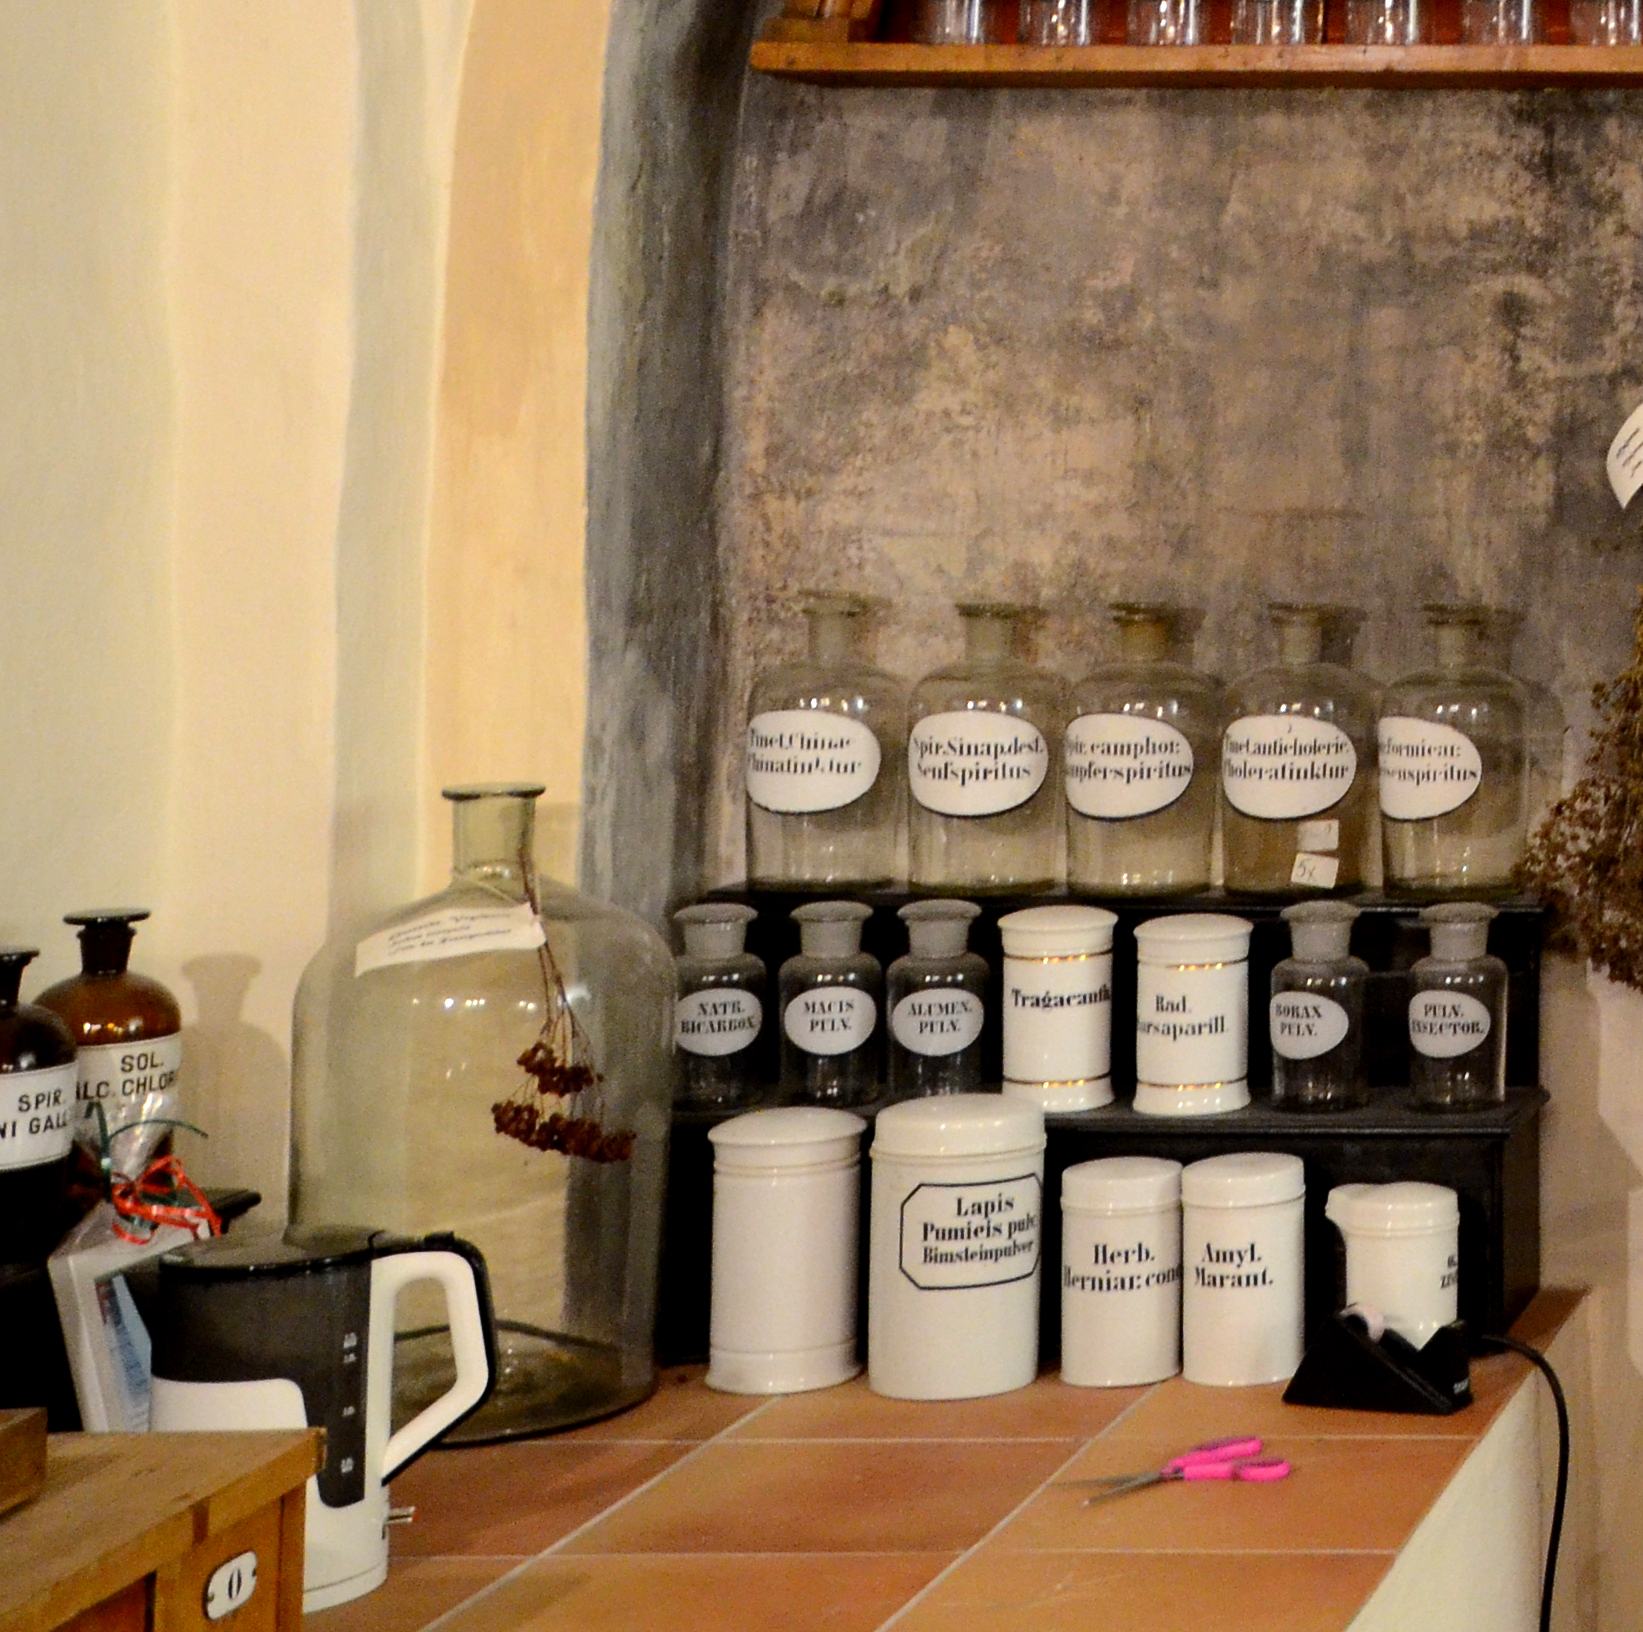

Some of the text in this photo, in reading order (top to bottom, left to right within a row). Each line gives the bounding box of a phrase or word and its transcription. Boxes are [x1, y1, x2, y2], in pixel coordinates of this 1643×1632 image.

[698, 1001, 746, 1017] NATR.
[803, 1000, 855, 1016] MACIS
[1155, 994, 1192, 1014] Rad.
[1274, 1004, 1322, 1020] BORAX
[1423, 1004, 1465, 1019] PULV.
[808, 1017, 852, 1033] PULV.
[918, 1018, 961, 1035] PULV.
[1278, 1022, 1318, 1038] PULV.
[118, 1051, 165, 1074] SOL.
[18, 1089, 66, 1113] SPIR.
[956, 1192, 1016, 1220] Lapis
[921, 1218, 1004, 1243] Pumicis
[921, 1239, 1035, 1266] Bimsteinpulver
[1093, 1241, 1156, 1266] Herb.
[1201, 1241, 1262, 1270] Amyl.
[1194, 1265, 1275, 1290] Marant.
